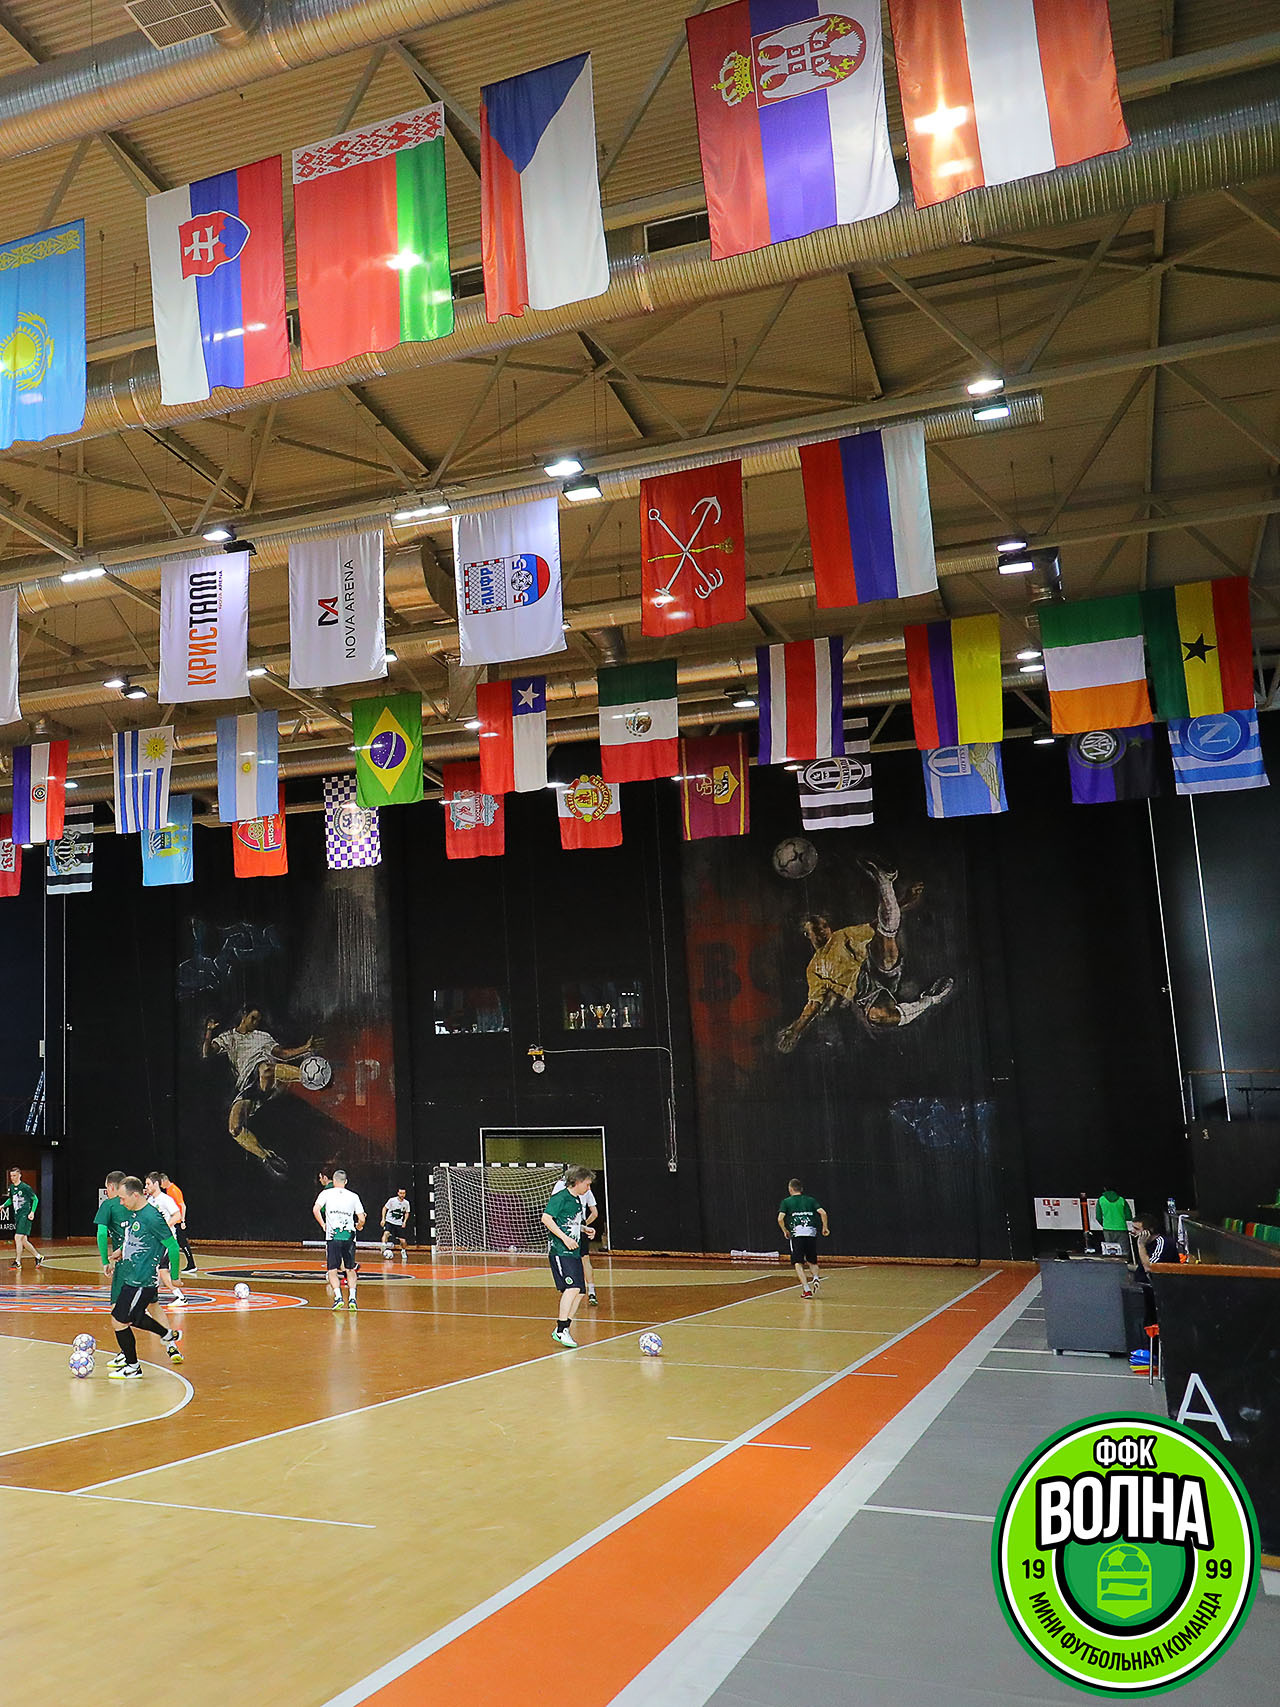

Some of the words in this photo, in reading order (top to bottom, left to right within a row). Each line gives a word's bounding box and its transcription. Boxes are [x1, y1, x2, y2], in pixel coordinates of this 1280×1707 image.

[343, 559, 354, 609] ARENA
[344, 612, 355, 660] NOVA
[592, 778, 609, 817] MANCHESTER
[2, 1223, 17, 1231] AREN
